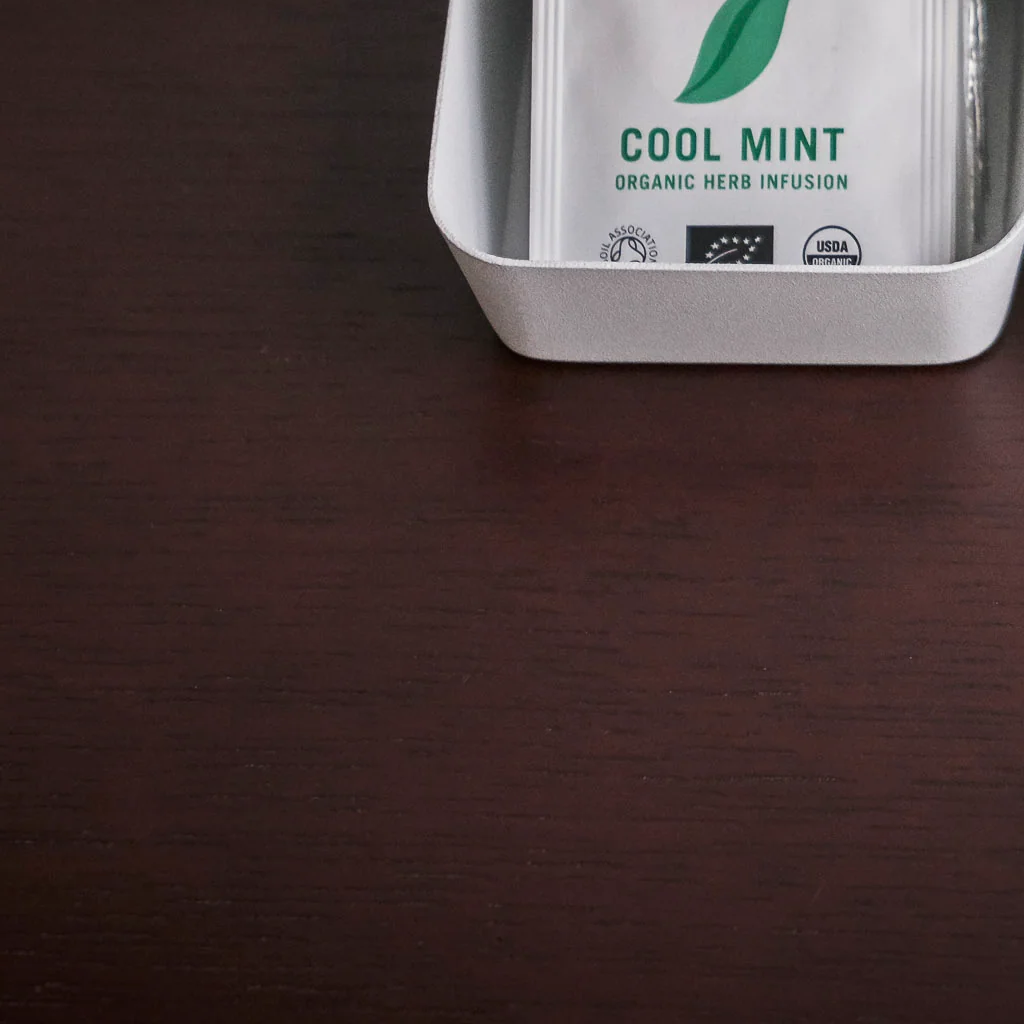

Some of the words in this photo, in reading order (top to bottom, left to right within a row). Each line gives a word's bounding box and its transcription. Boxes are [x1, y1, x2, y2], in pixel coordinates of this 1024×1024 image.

[620, 127, 720, 162] COOL
[741, 127, 844, 162] MINT
[615, 174, 695, 190] ORGANIC
[704, 174, 751, 190] HERB
[760, 174, 848, 190] INFUSION
[817, 240, 849, 253] USDA
